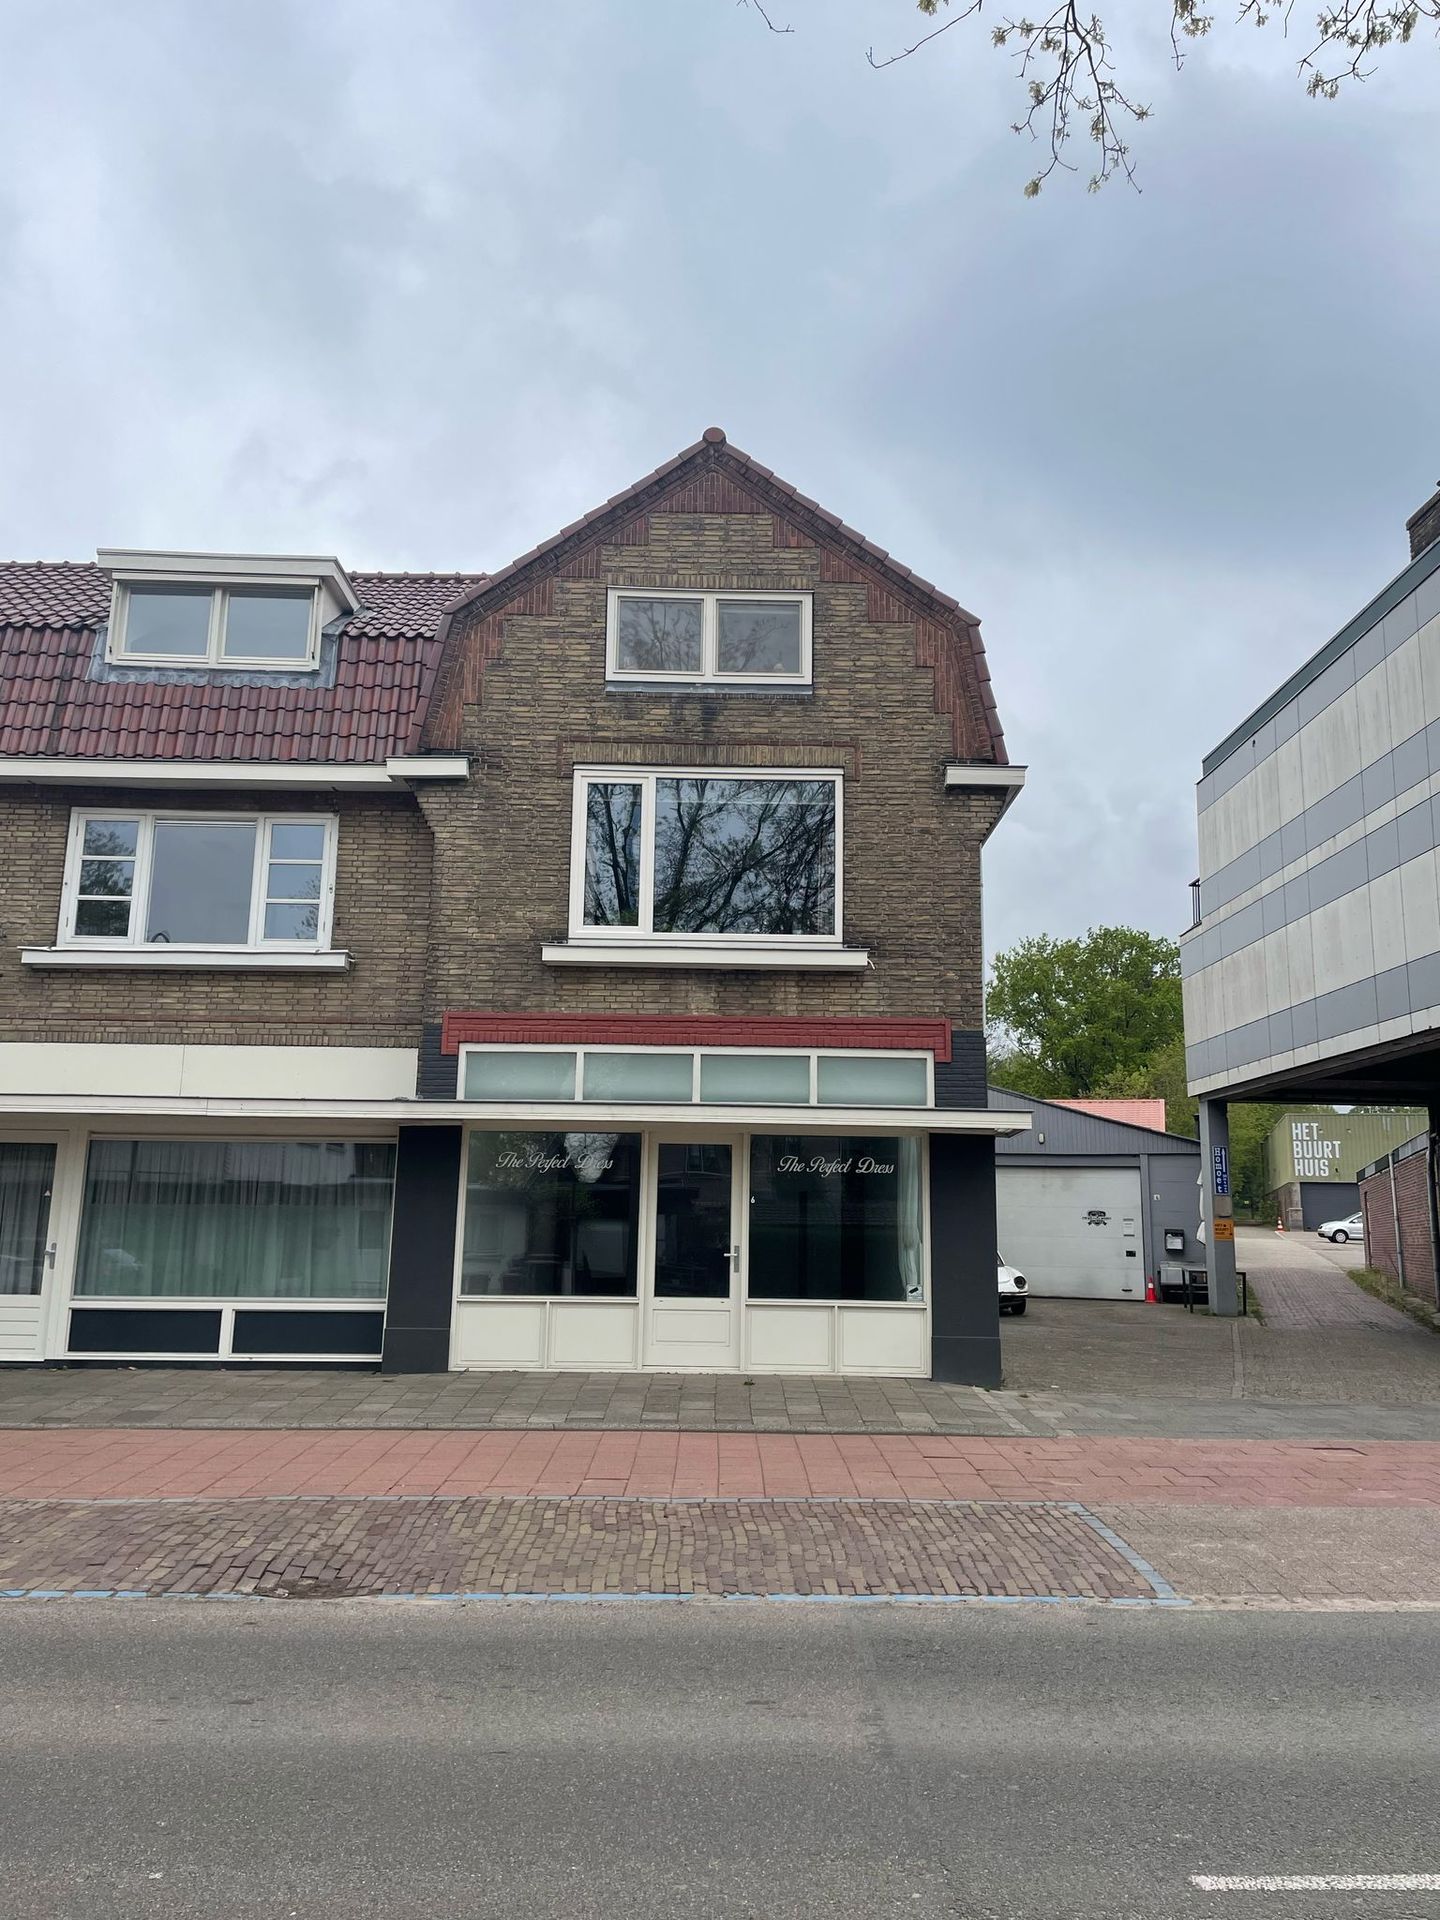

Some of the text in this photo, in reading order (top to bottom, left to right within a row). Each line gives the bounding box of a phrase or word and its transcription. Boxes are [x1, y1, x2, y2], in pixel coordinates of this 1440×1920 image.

[1292, 1122, 1319, 1140] HET
[1293, 1140, 1341, 1158] BUURT
[496, 1151, 524, 1168] The
[525, 1152, 571, 1173] Perfect
[777, 1155, 895, 1178] The Perfect Dress
[1295, 1159, 1329, 1176] HUIS
